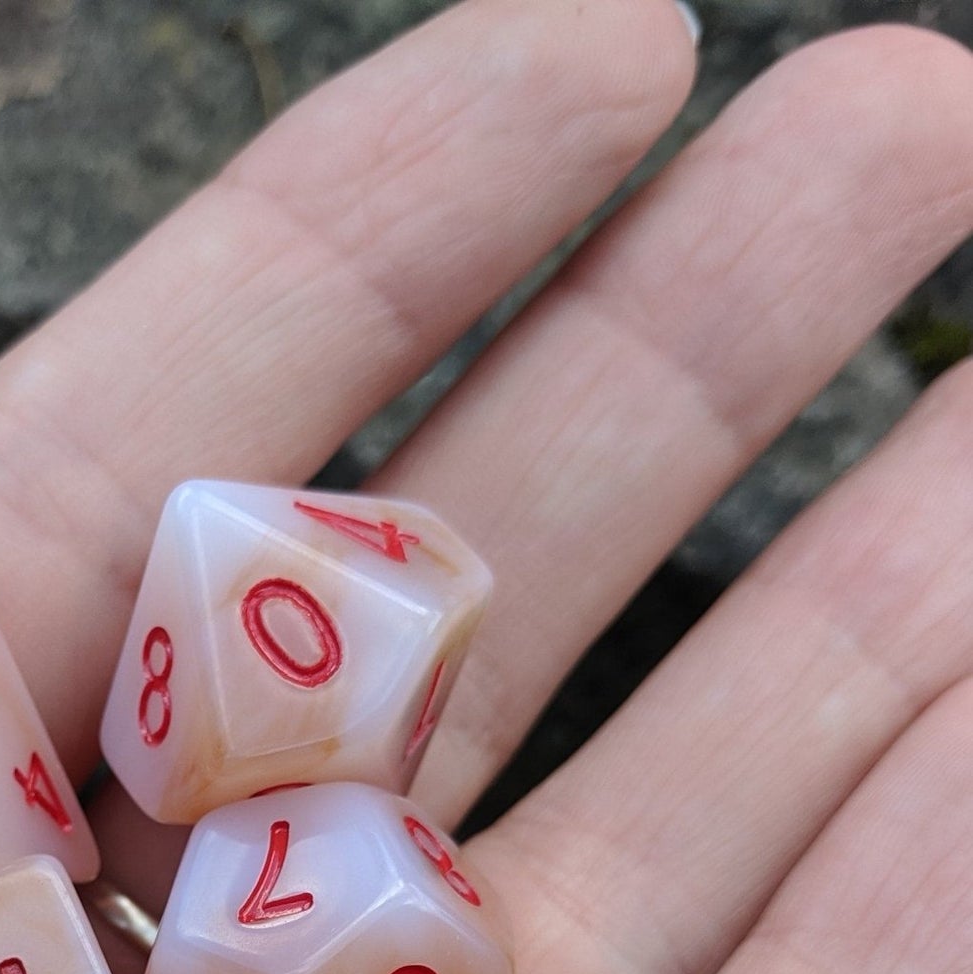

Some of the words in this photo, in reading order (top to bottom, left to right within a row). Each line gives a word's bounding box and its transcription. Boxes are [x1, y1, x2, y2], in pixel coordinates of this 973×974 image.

[293, 501, 420, 563] 4
[240, 577, 343, 688] 0
[137, 625, 174, 748] 8
[12, 751, 74, 834] 4
[237, 820, 314, 925] 7
[403, 815, 482, 907] 8
